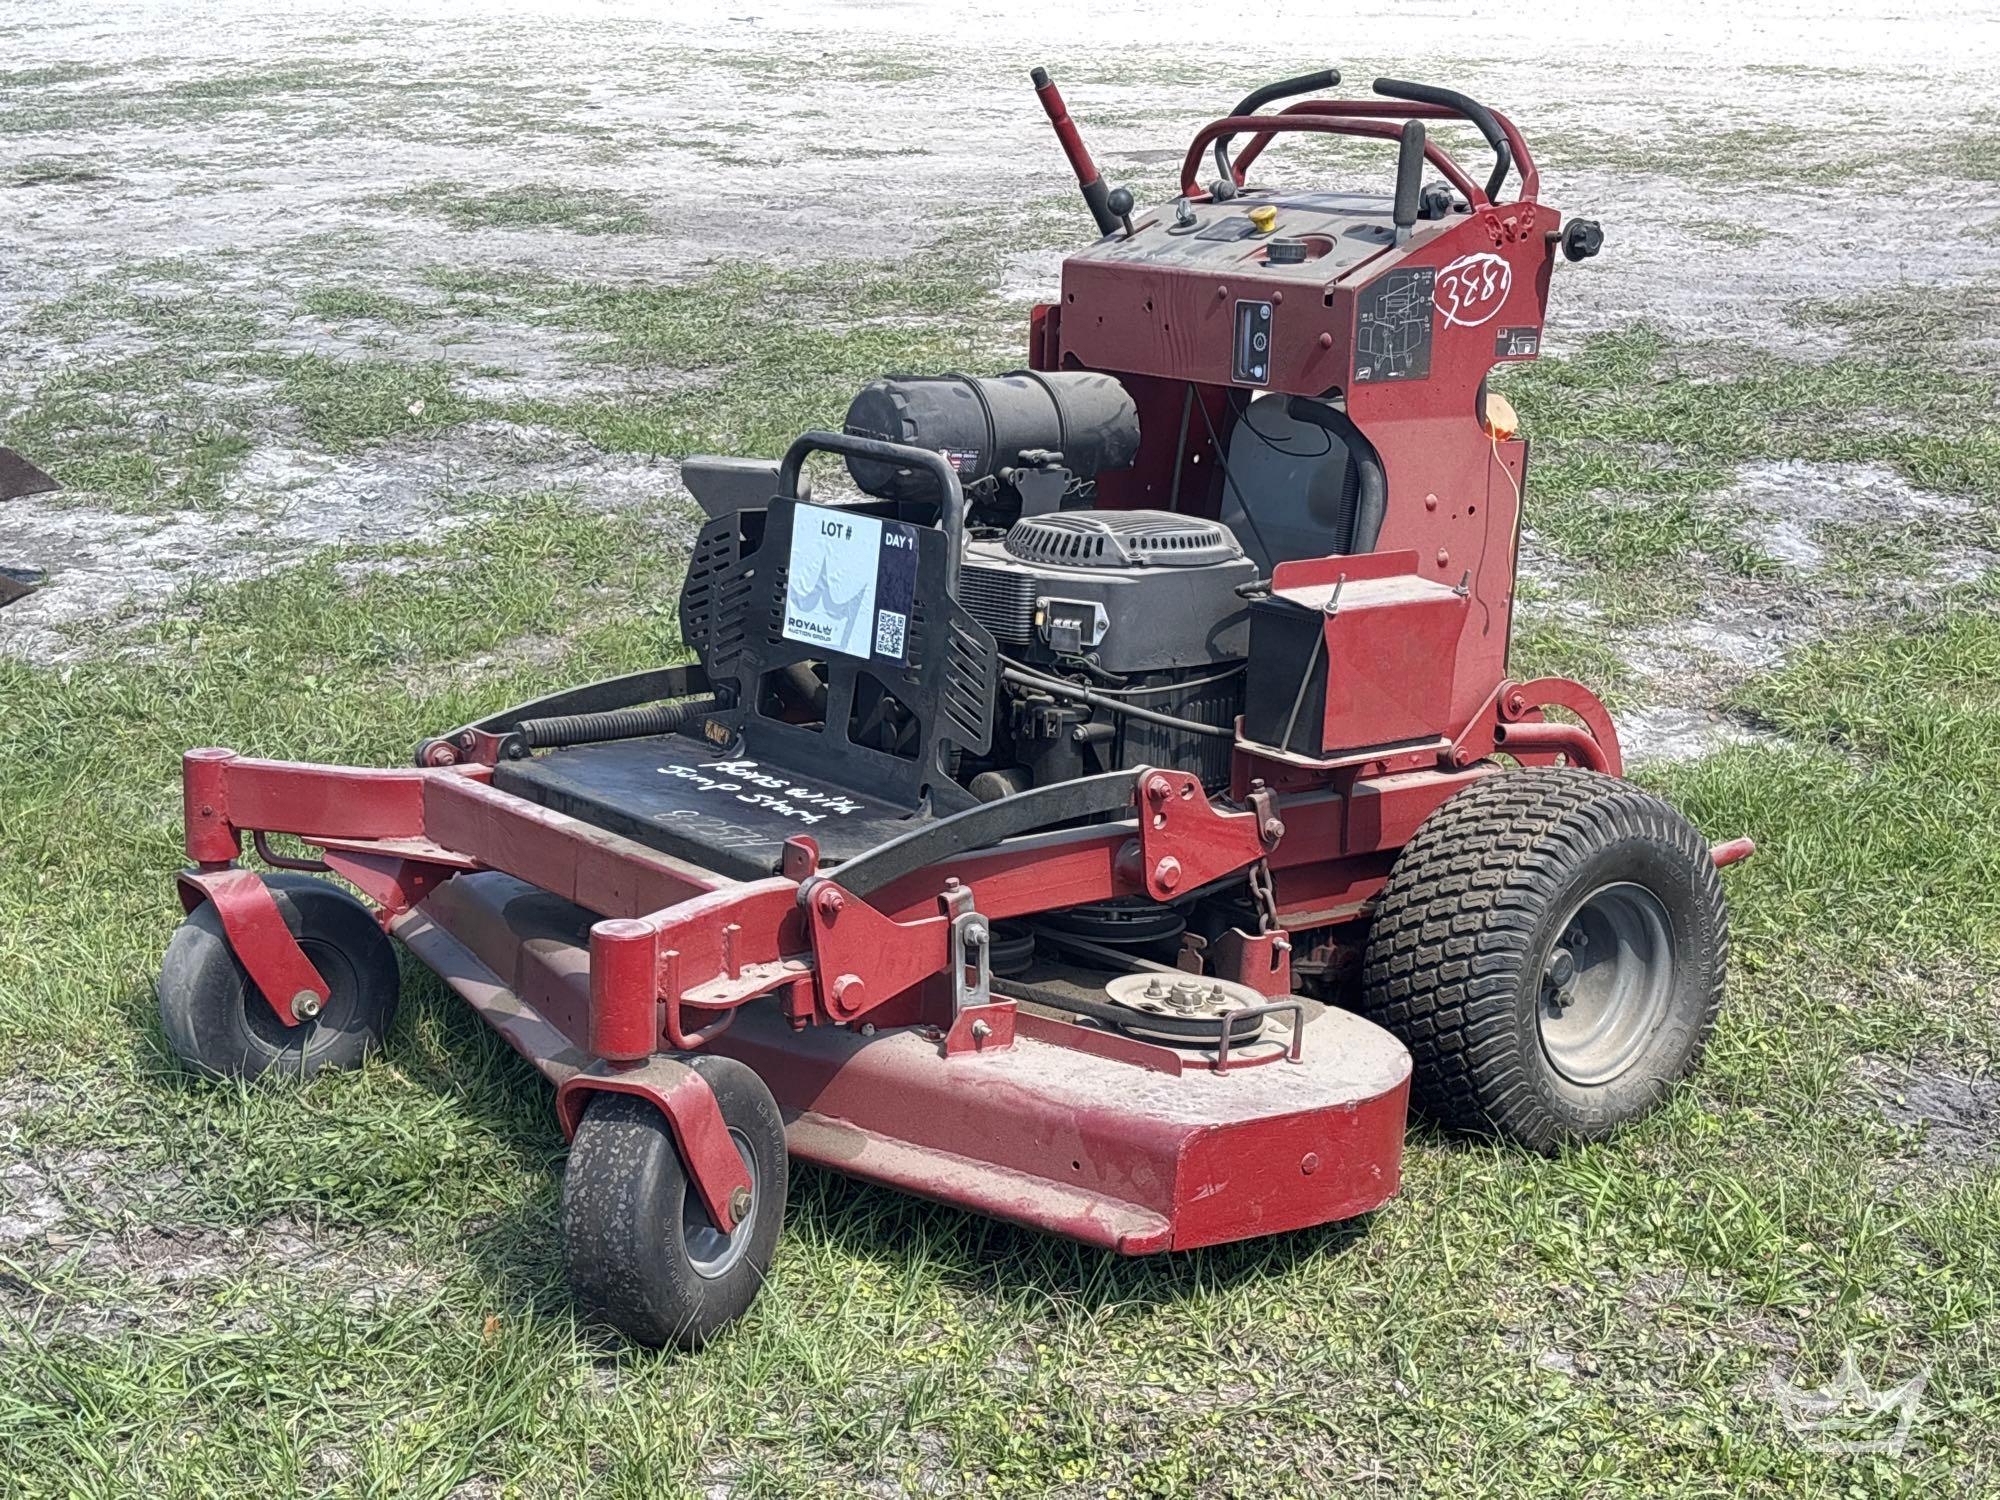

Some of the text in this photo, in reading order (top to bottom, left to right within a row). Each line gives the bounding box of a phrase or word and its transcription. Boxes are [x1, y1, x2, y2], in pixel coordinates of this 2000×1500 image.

[821, 519, 853, 541] LOT #
[885, 532, 913, 550] DAY 1
[788, 617, 823, 634] ROYAL
[788, 627, 832, 642] AUCTION GROUP
[657, 764, 828, 825] Jump Start
